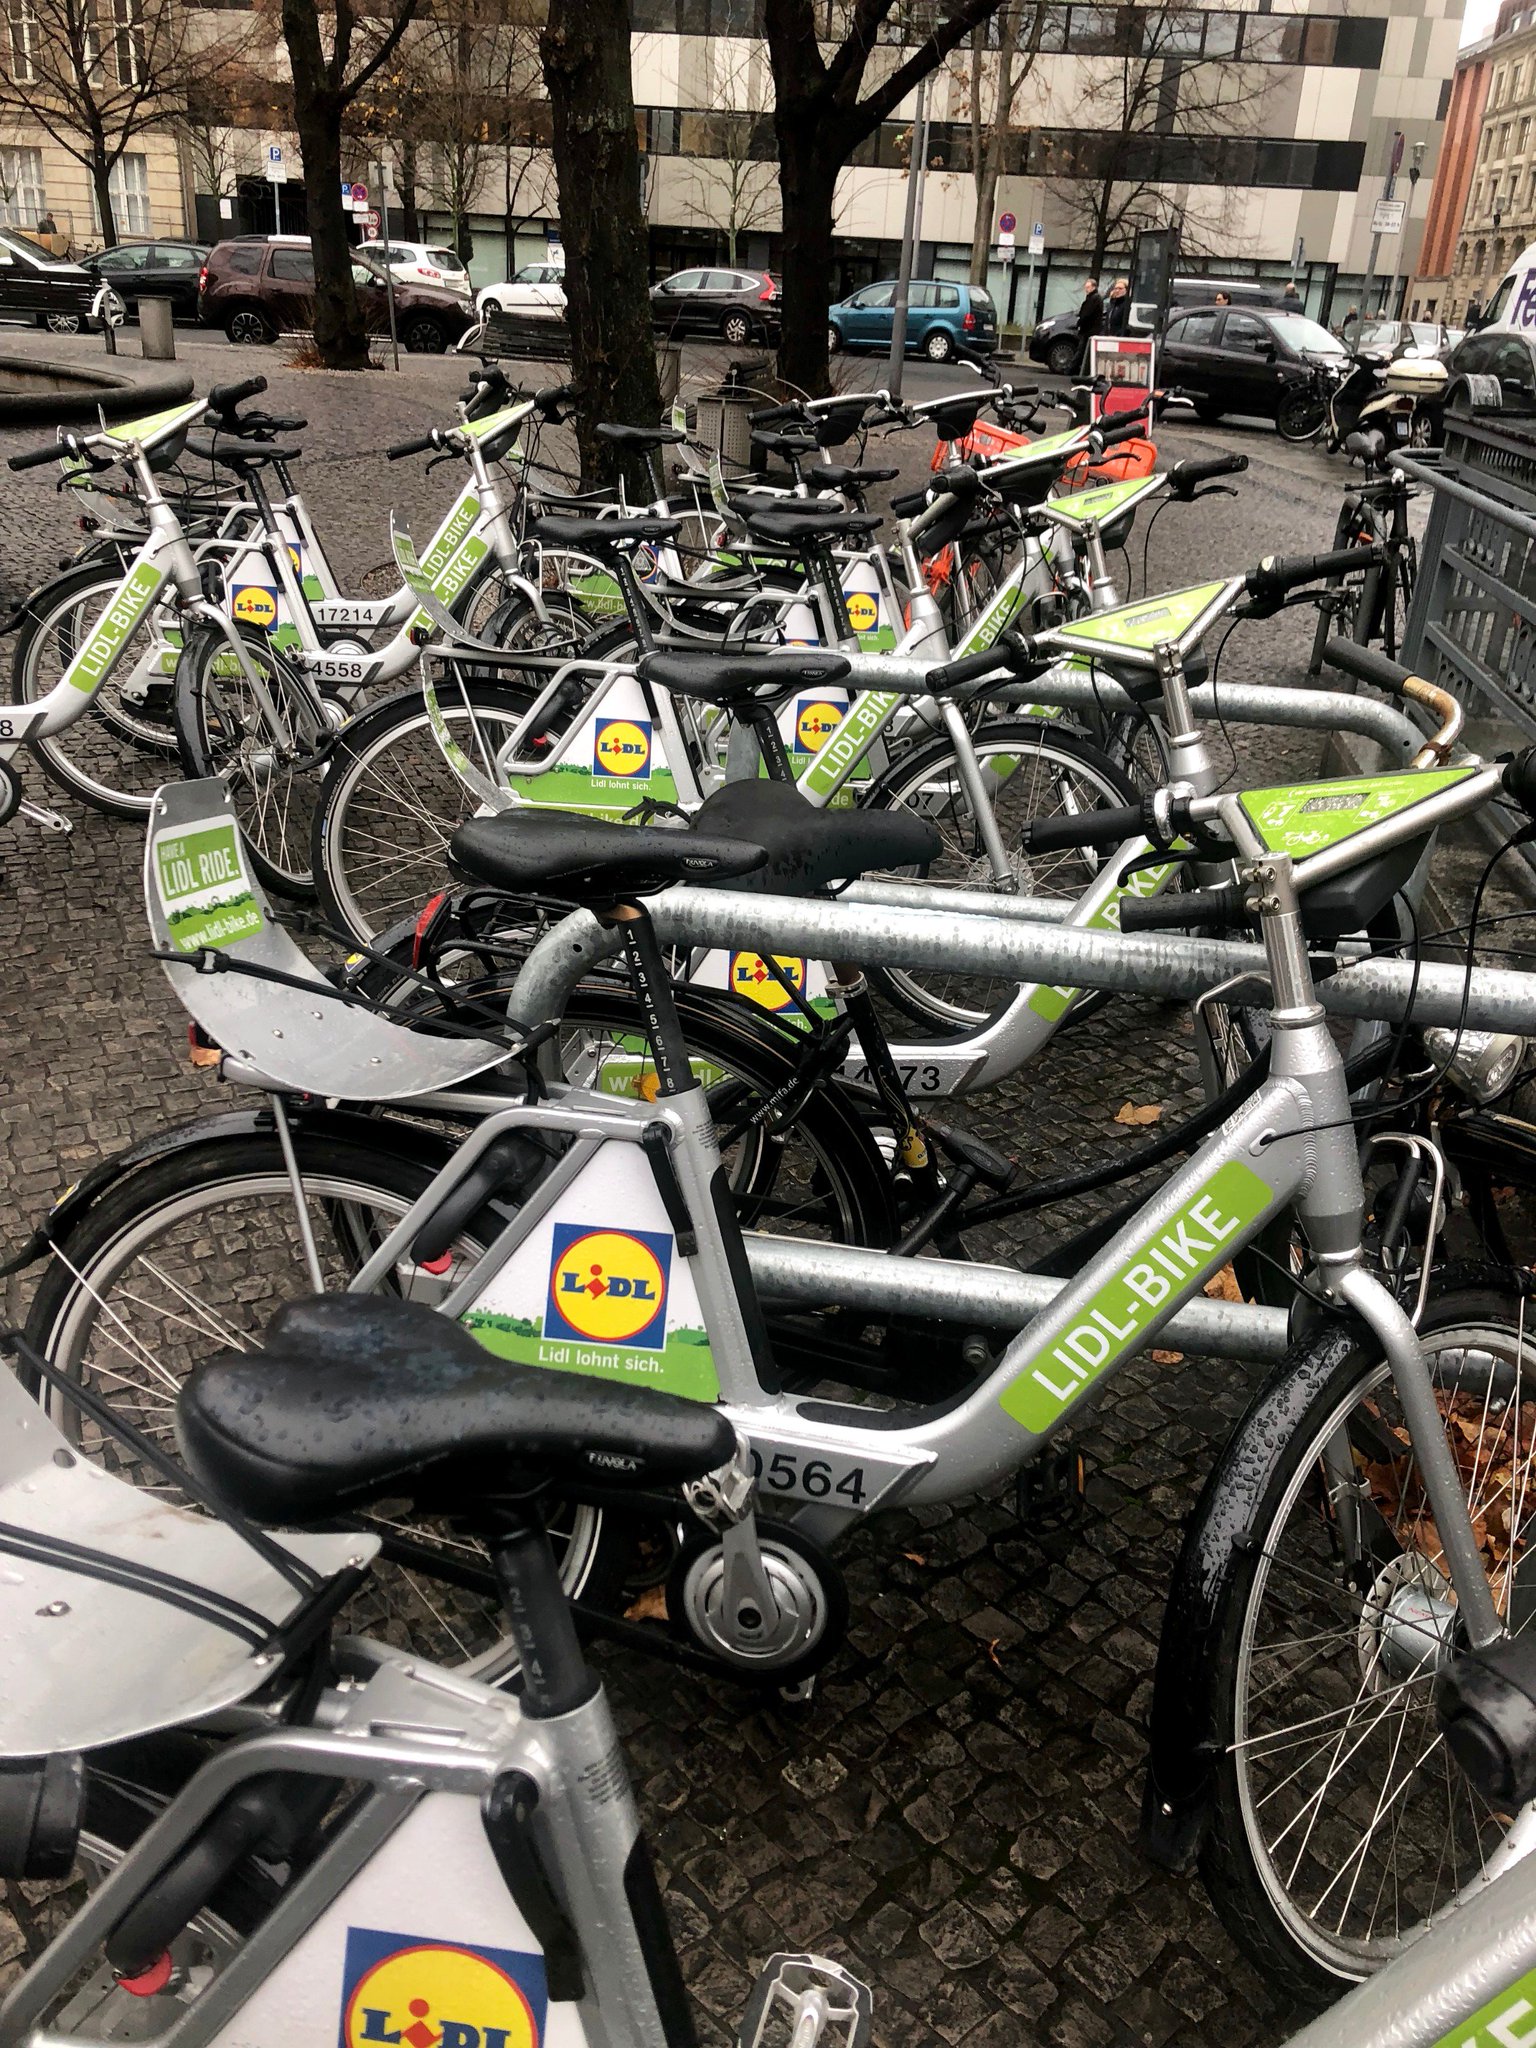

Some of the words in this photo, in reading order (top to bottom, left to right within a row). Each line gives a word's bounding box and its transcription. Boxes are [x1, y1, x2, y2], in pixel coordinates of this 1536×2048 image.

[422, 507, 474, 581] LIDL-BIKE
[415, 549, 478, 631] LI-BIKE
[79, 577, 151, 678] LIDL-BIKE
[317, 608, 374, 622] 17214
[819, 691, 895, 779] LIDL-BIK
[591, 779, 606, 788] Lidl
[608, 780, 630, 789] lohnt
[632, 782, 652, 791] sich.
[162, 859, 200, 896] LIDL
[198, 847, 240, 885] RIDE.
[179, 909, 260, 951] www.lidl-bike.de
[749, 1076, 800, 1125] www.mifa.de
[1031, 1193, 1241, 1402] LIDL-BIKE
[538, 1345, 570, 1364] Lidl
[575, 1349, 620, 1370] lohnt
[624, 1355, 664, 1374] sich.
